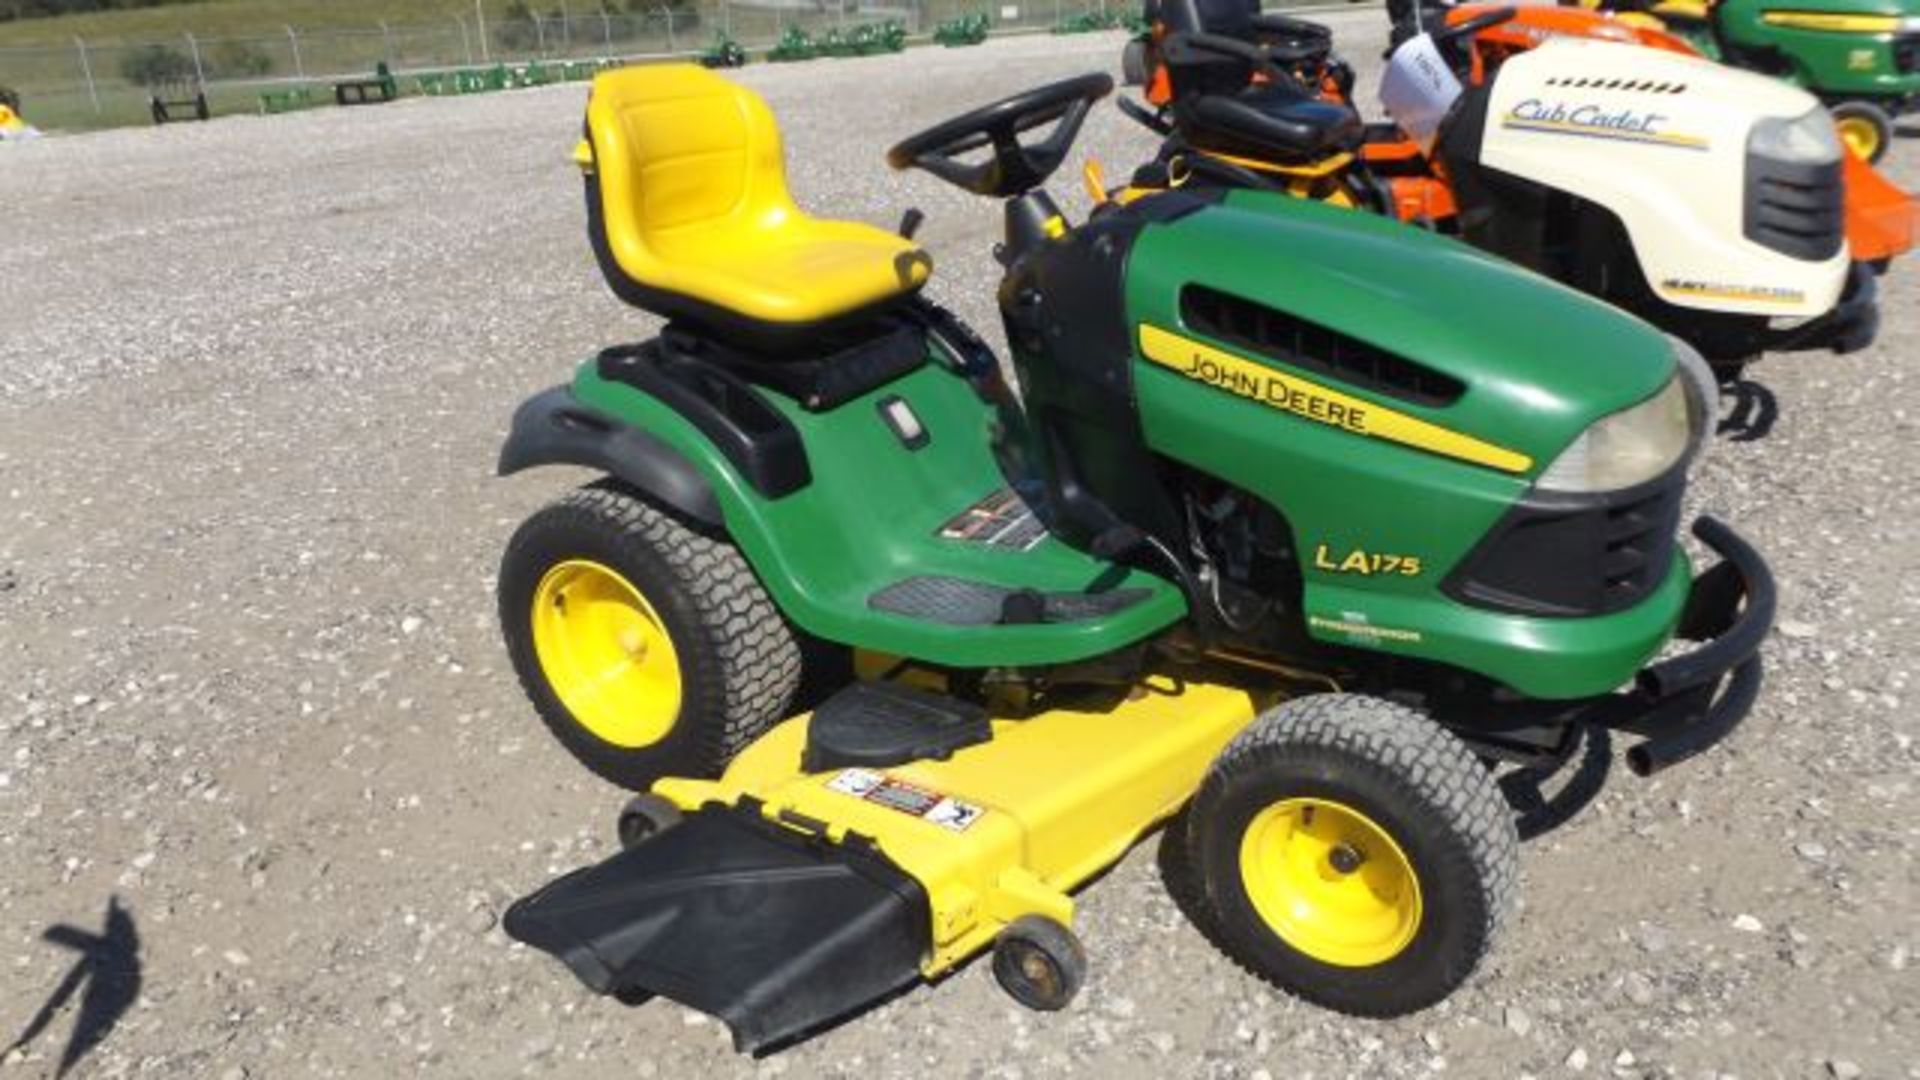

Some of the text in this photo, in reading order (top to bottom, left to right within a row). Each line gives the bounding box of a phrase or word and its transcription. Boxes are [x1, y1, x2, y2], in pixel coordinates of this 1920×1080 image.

[1511, 99, 1668, 135] Cub Cadet
[1186, 353, 1367, 430] JOHN DEERE
[1315, 544, 1421, 576] LA175
